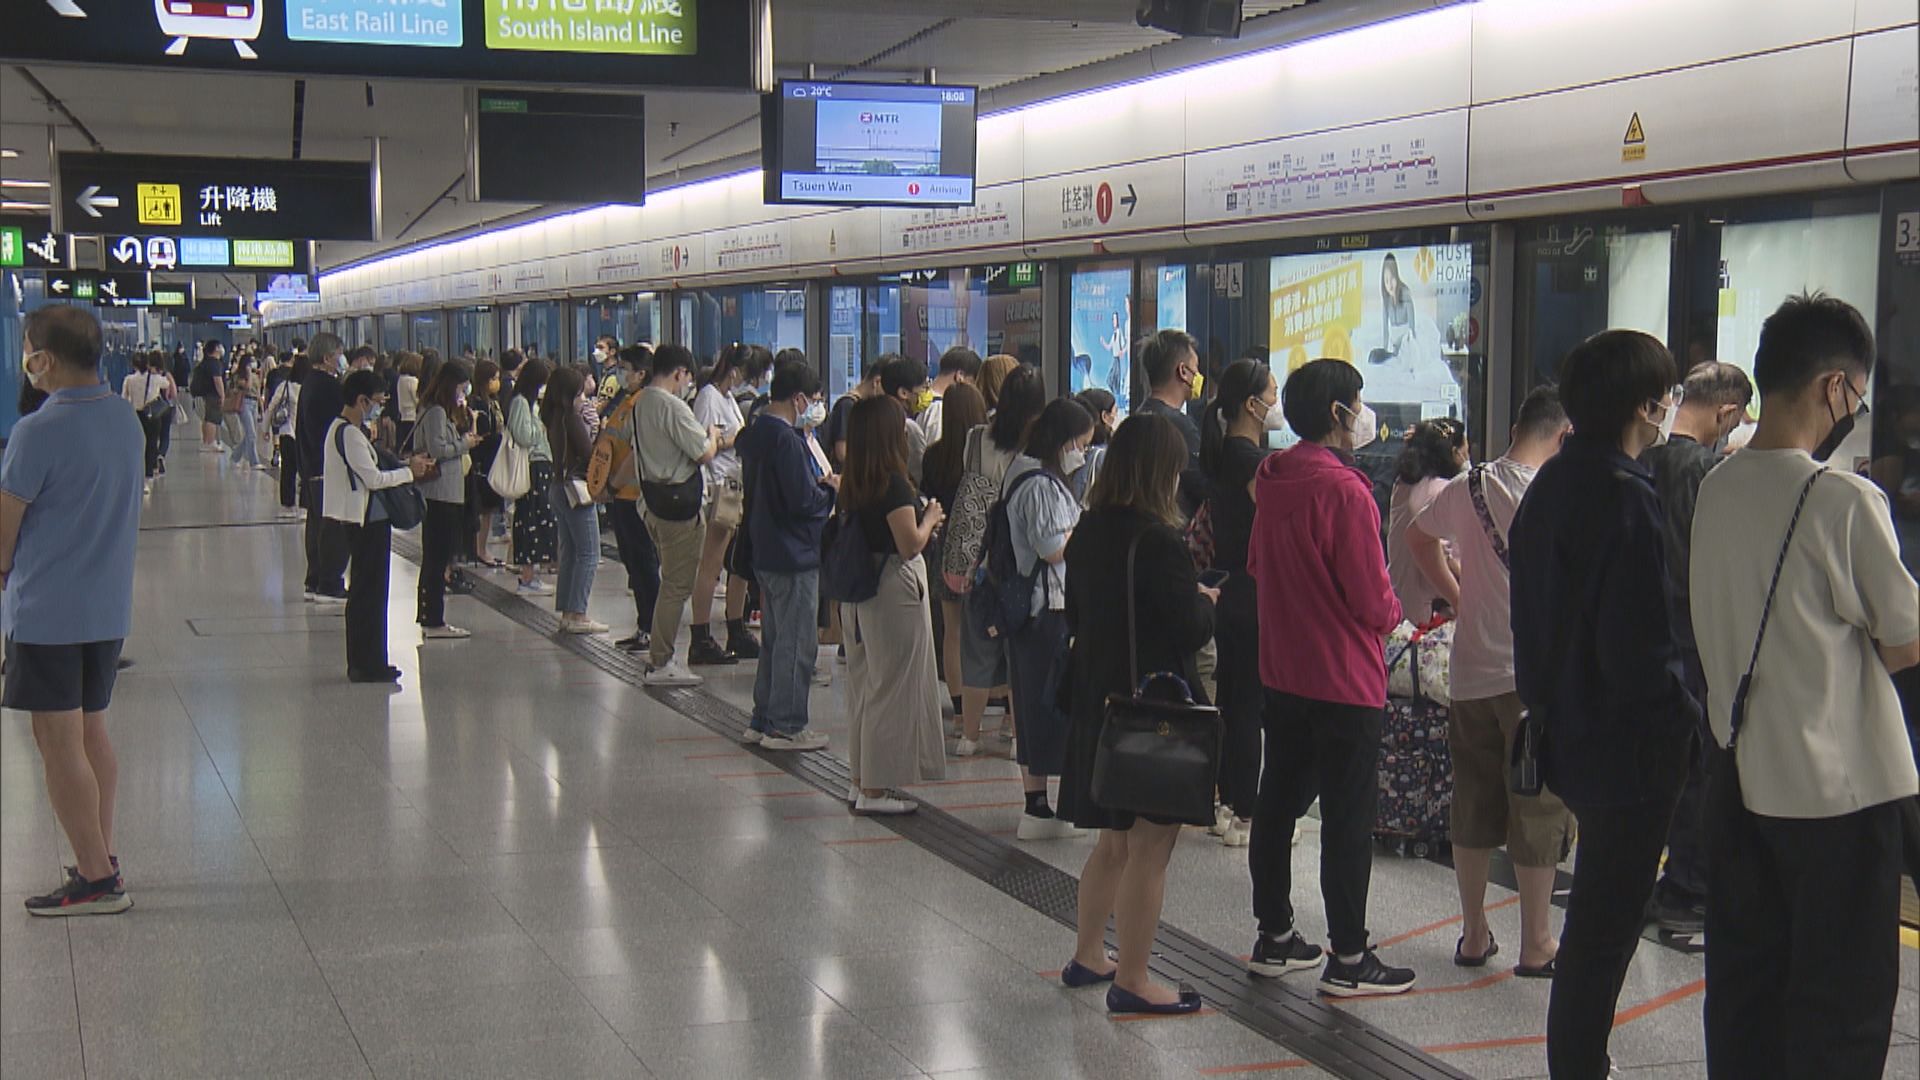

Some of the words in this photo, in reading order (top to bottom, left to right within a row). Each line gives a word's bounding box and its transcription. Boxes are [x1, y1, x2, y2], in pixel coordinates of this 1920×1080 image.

[302, 8, 349, 30] East
[355, 11, 395, 32] Rail
[402, 13, 449, 35] Line
[498, 15, 563, 41] South
[569, 19, 632, 42] Island
[639, 21, 683, 44] Line
[874, 113, 899, 123] MTR
[792, 180, 825, 191] Tsuen
[827, 181, 852, 192] Wan
[200, 185, 277, 211] 升降機
[200, 212, 222, 226] Lift
